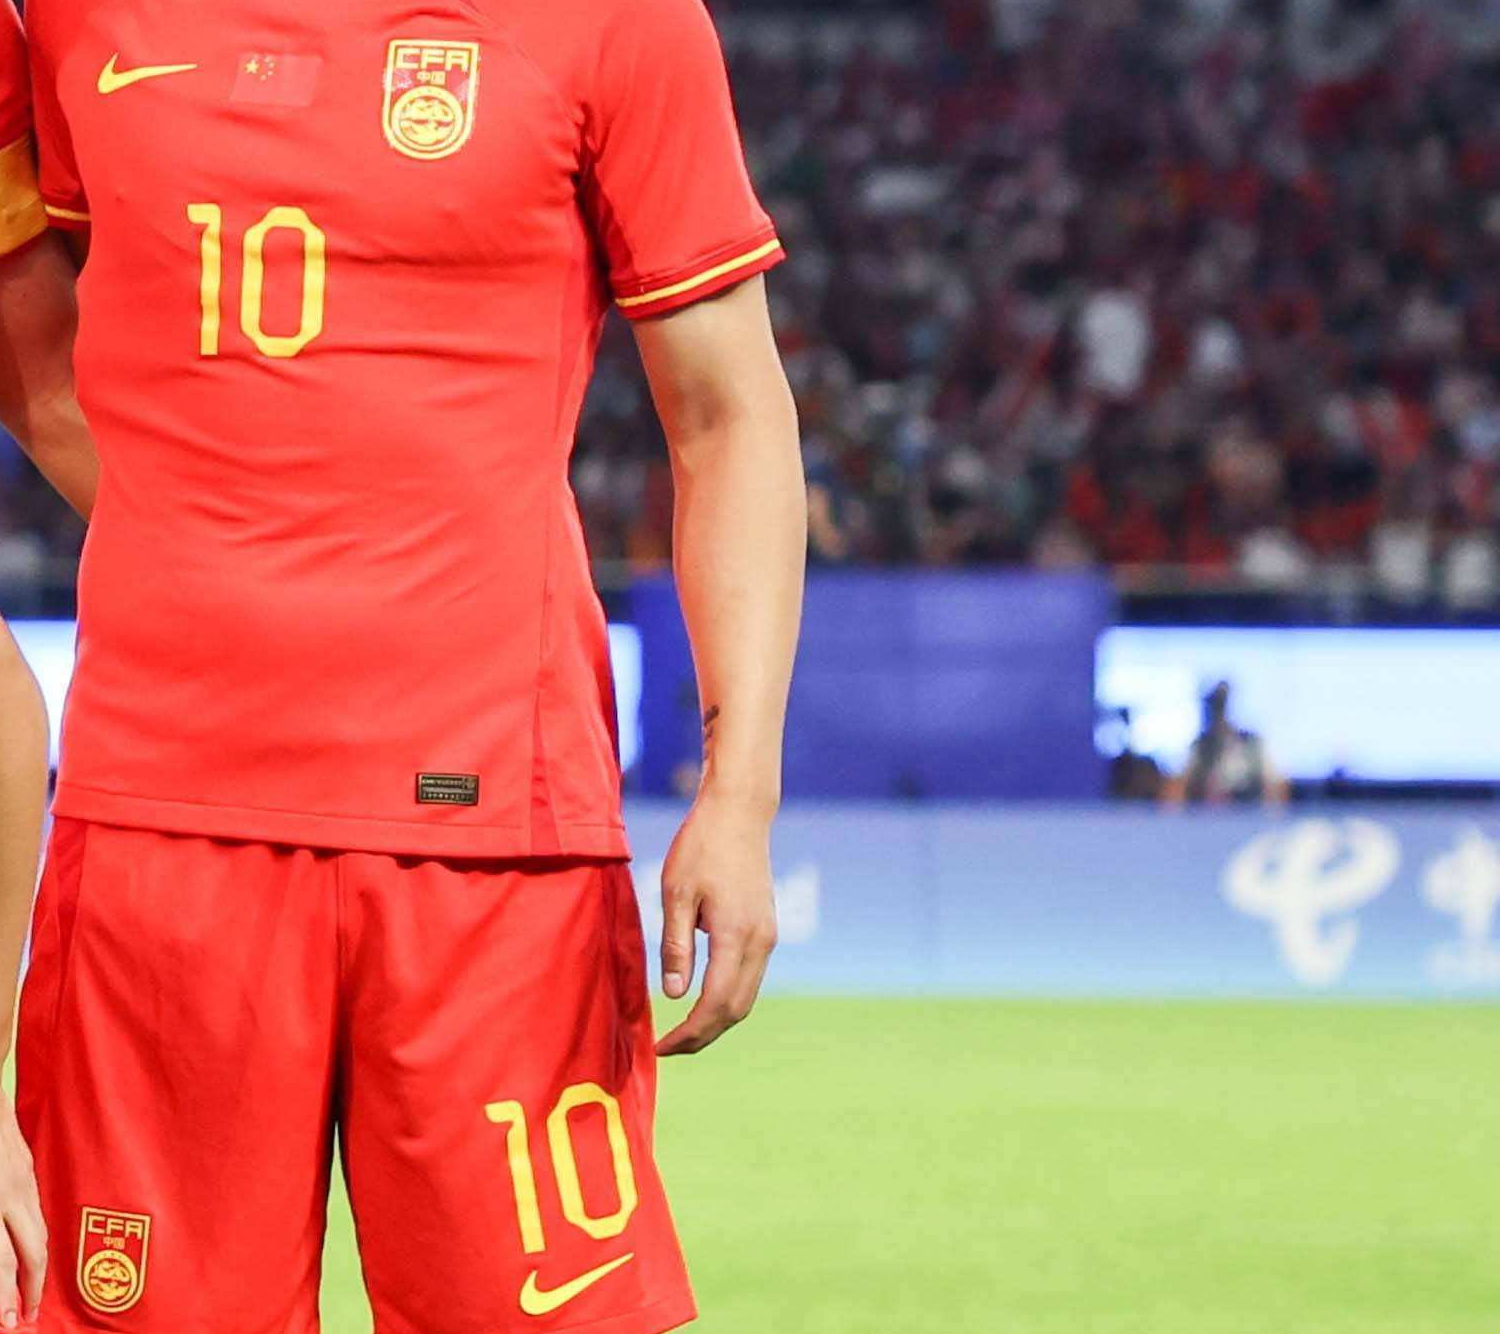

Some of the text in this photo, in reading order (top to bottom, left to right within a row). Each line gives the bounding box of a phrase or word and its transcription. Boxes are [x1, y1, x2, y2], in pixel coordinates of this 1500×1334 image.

[397, 48, 469, 72] CFA
[186, 203, 326, 357] 10
[485, 1081, 639, 1254] 10
[88, 1216, 143, 1240] CFA
